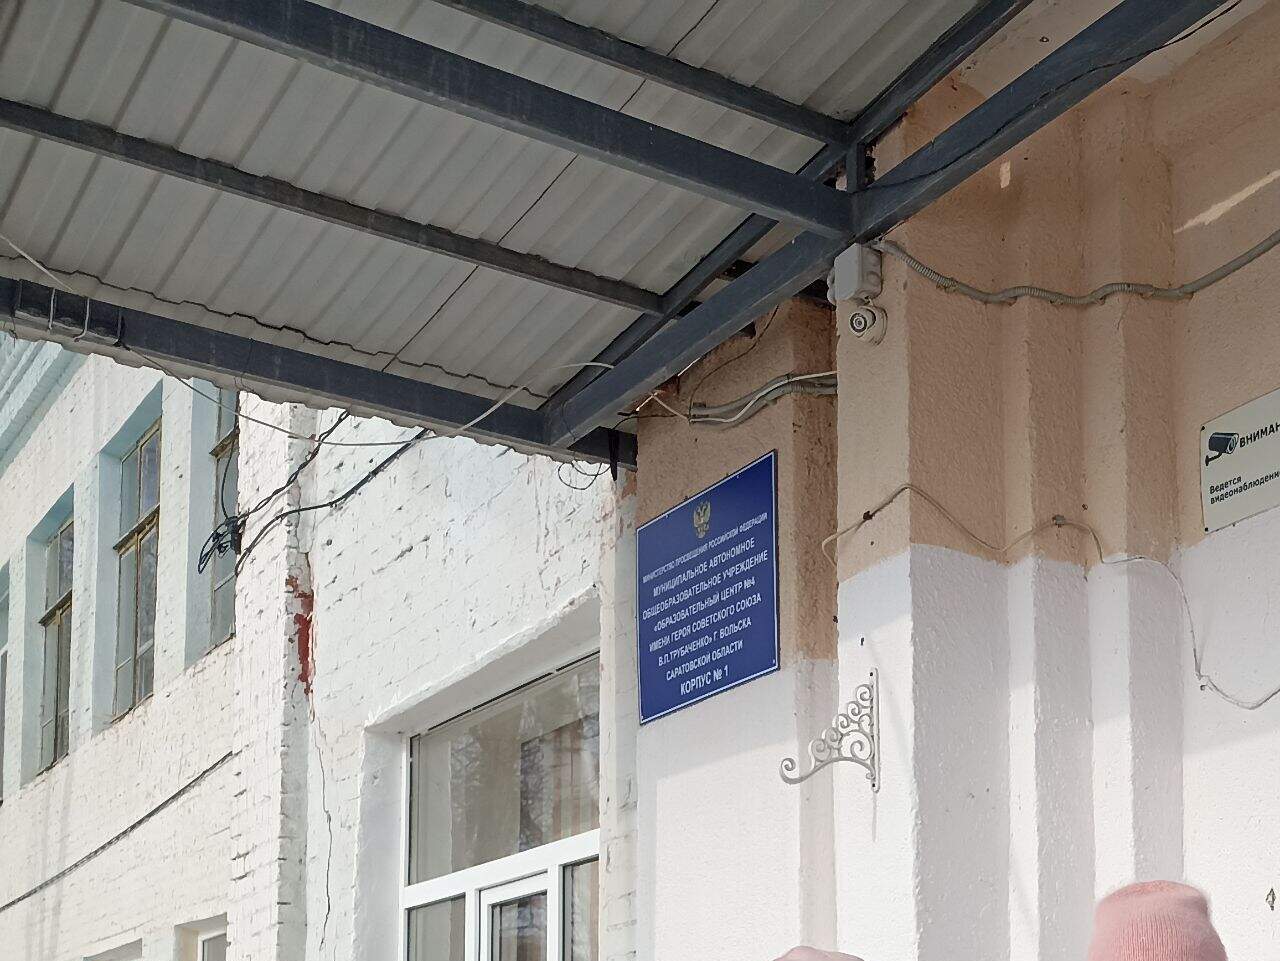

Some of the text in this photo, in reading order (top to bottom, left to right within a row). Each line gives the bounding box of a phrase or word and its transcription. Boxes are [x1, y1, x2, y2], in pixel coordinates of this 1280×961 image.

[1209, 475, 1242, 494] Ведется
[642, 550, 768, 620] ОБЩЕОБРАЗОВАТЕЛЬНОЕ УЧРЕЖДЕНИЕ
[653, 537, 755, 597] МУНИЦИПАЛЬНОЕ АВТОНОМНОЕ
[649, 592, 762, 652] ИМЕНИ ГЕРОЯ СОВЕТСКОГО СОЮЗА
[653, 591, 720, 632] «ОБРАЗОВАТЕЛЬНЫЙ
[720, 581, 743, 603] ЦЕНТР
[719, 616, 752, 639] ВОЛЬСКА
[666, 639, 744, 681] САРАТОВСКОЙ ОБЛАСТИ
[680, 664, 729, 696] КОРПУС № 1
